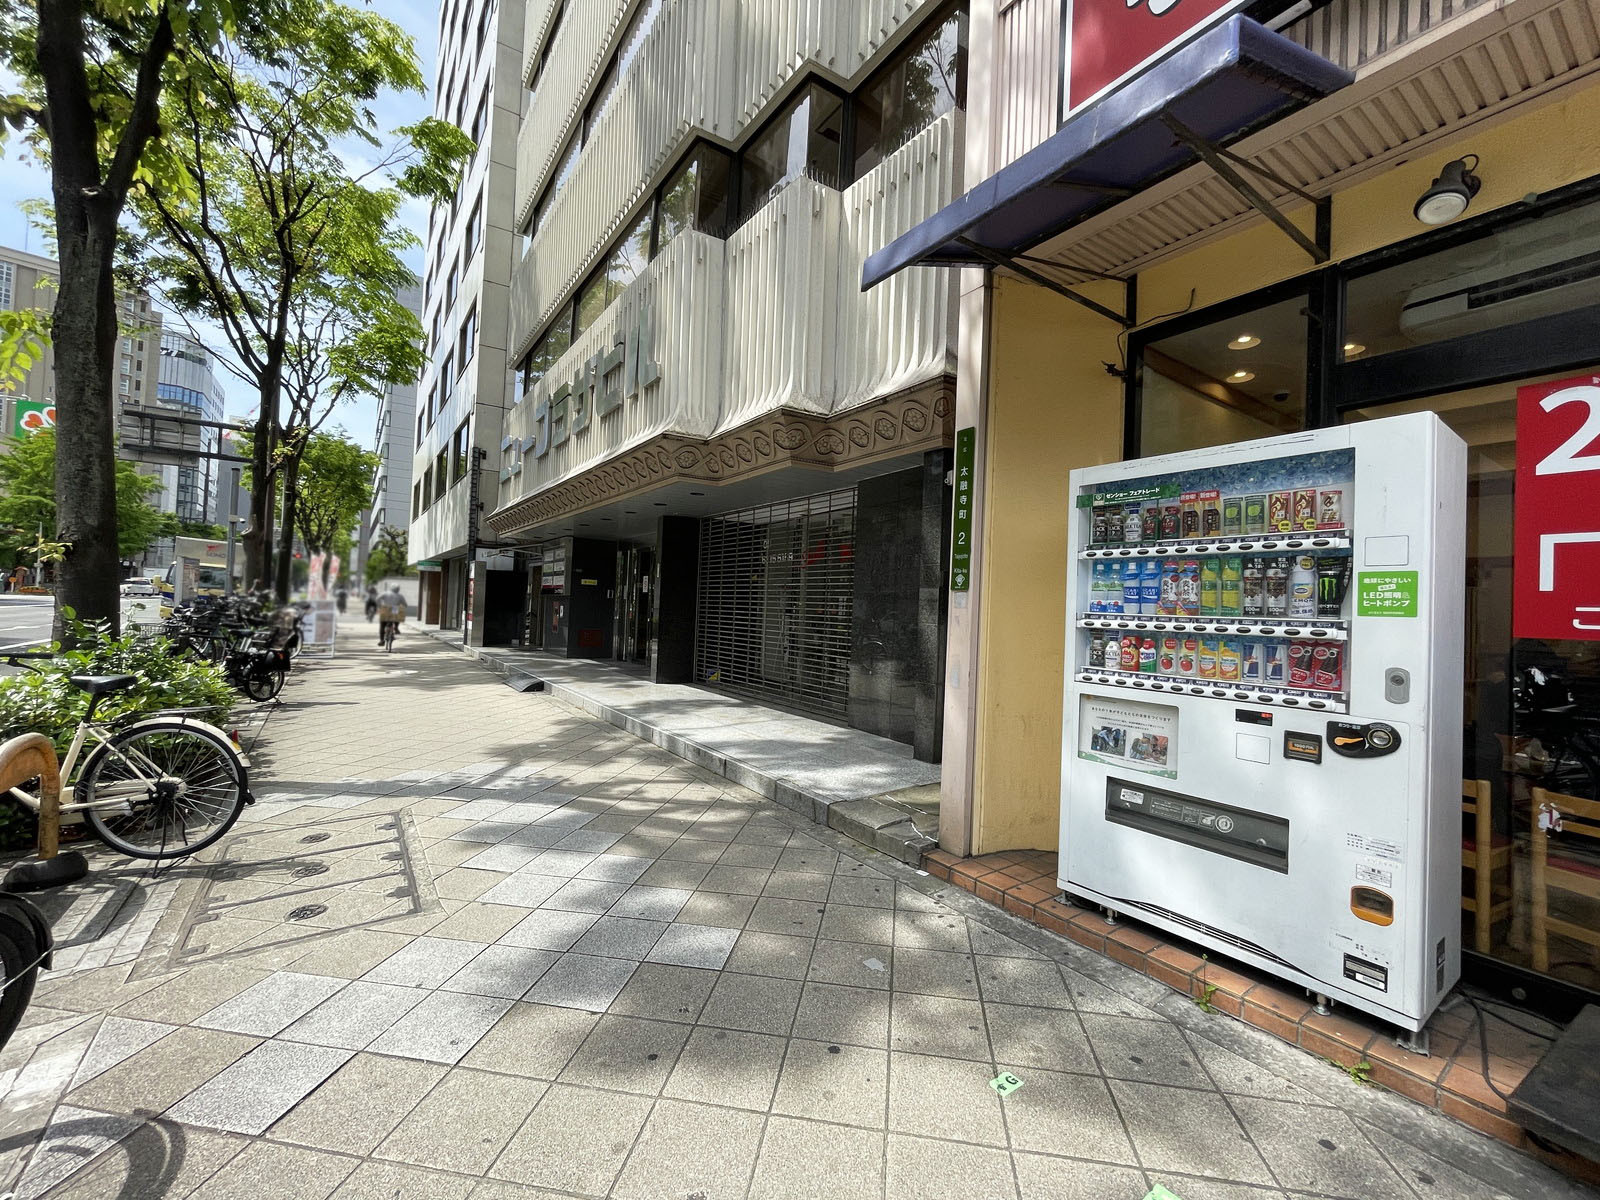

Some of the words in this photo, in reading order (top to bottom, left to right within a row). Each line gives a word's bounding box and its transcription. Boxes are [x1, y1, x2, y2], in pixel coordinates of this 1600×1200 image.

[1129, 487, 1160, 496] フェアトレード
[957, 532, 966, 545] 2
[1363, 599, 1411, 607] ヒートポンプ
